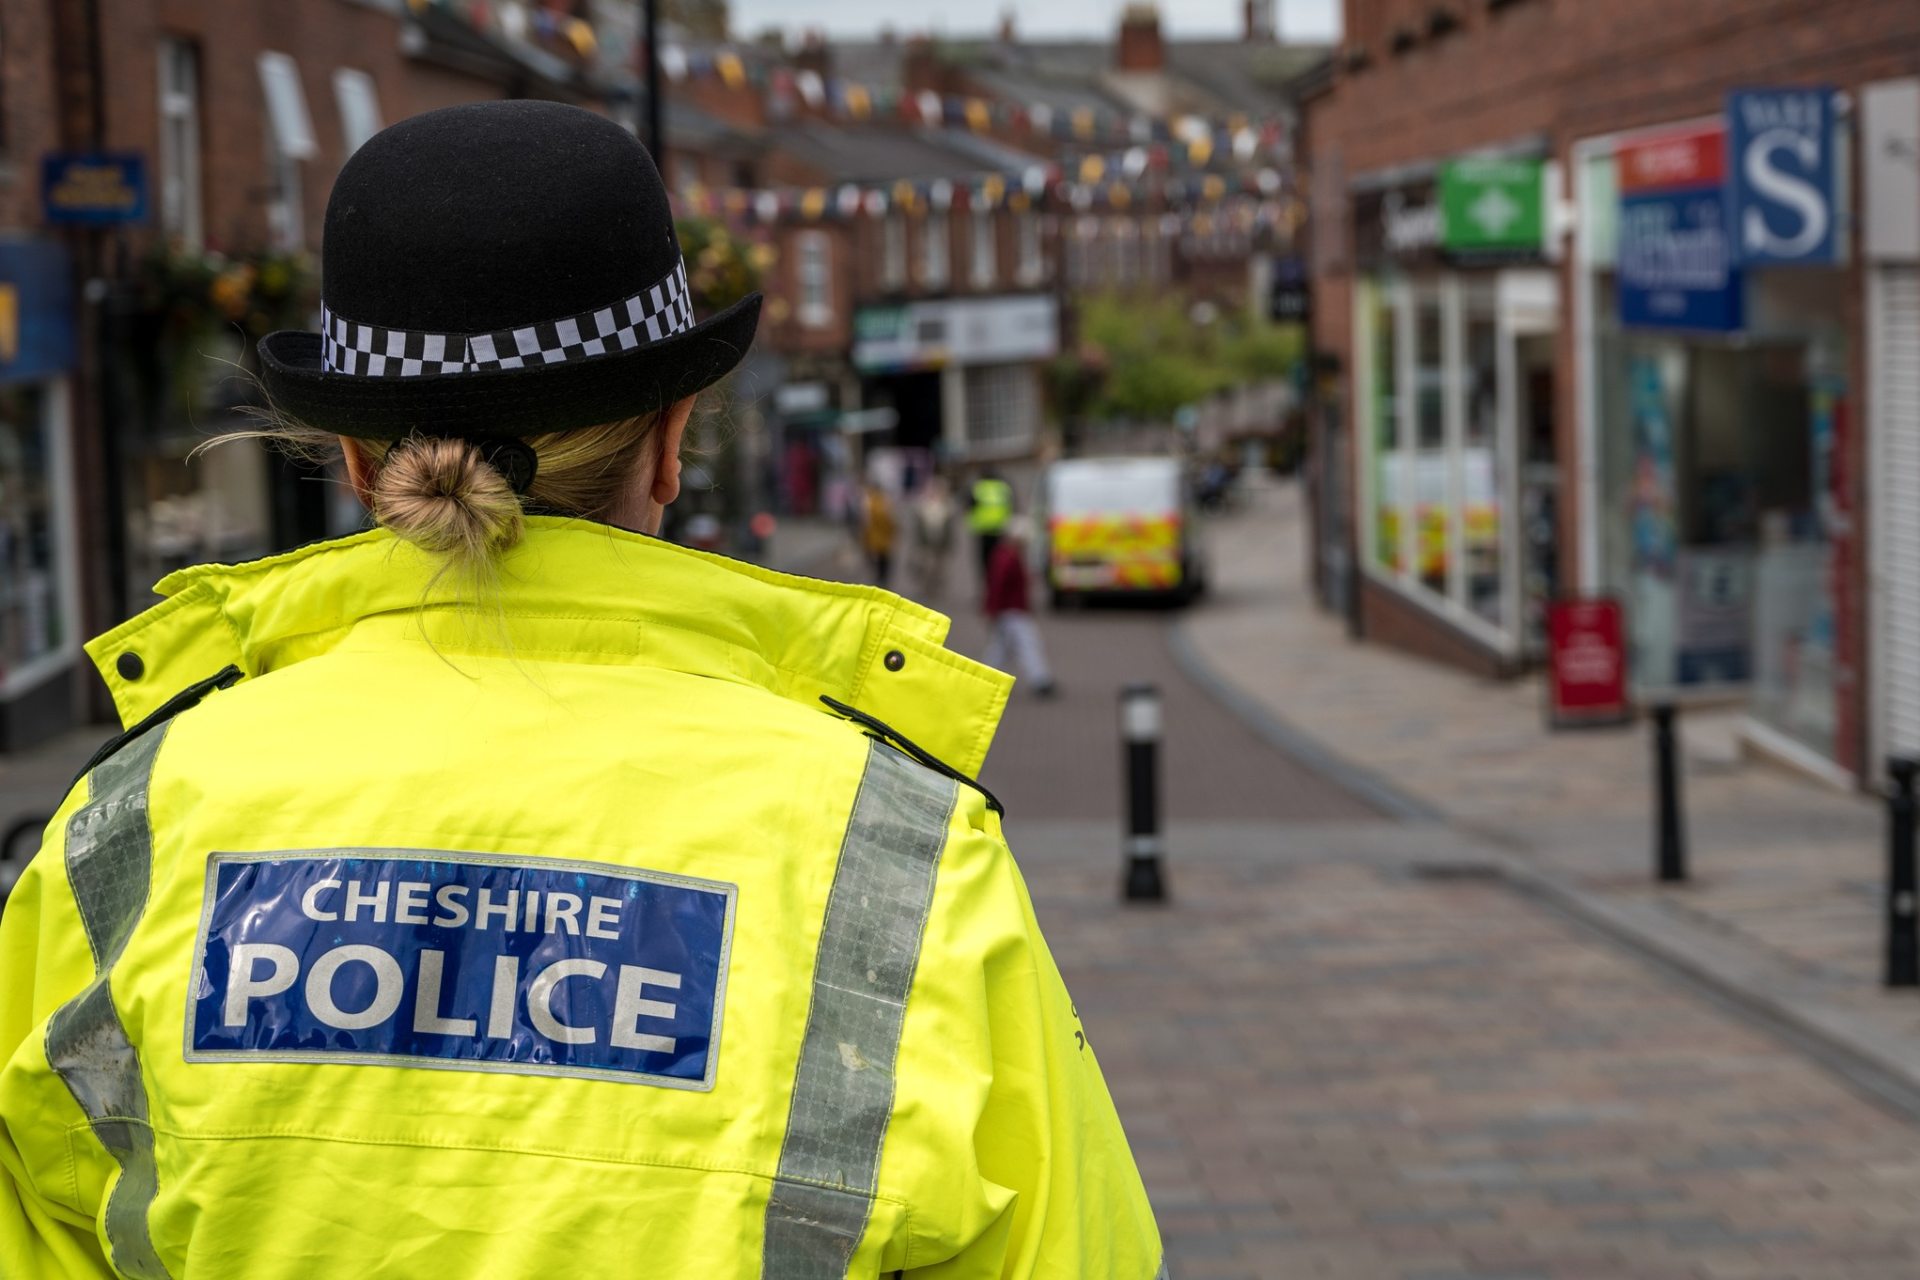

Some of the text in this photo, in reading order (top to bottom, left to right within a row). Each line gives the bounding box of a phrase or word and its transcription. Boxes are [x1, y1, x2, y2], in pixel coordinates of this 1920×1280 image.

[1745, 129, 1826, 257] S
[302, 879, 622, 940] CHESHIRE
[224, 944, 681, 1054] POLICE
